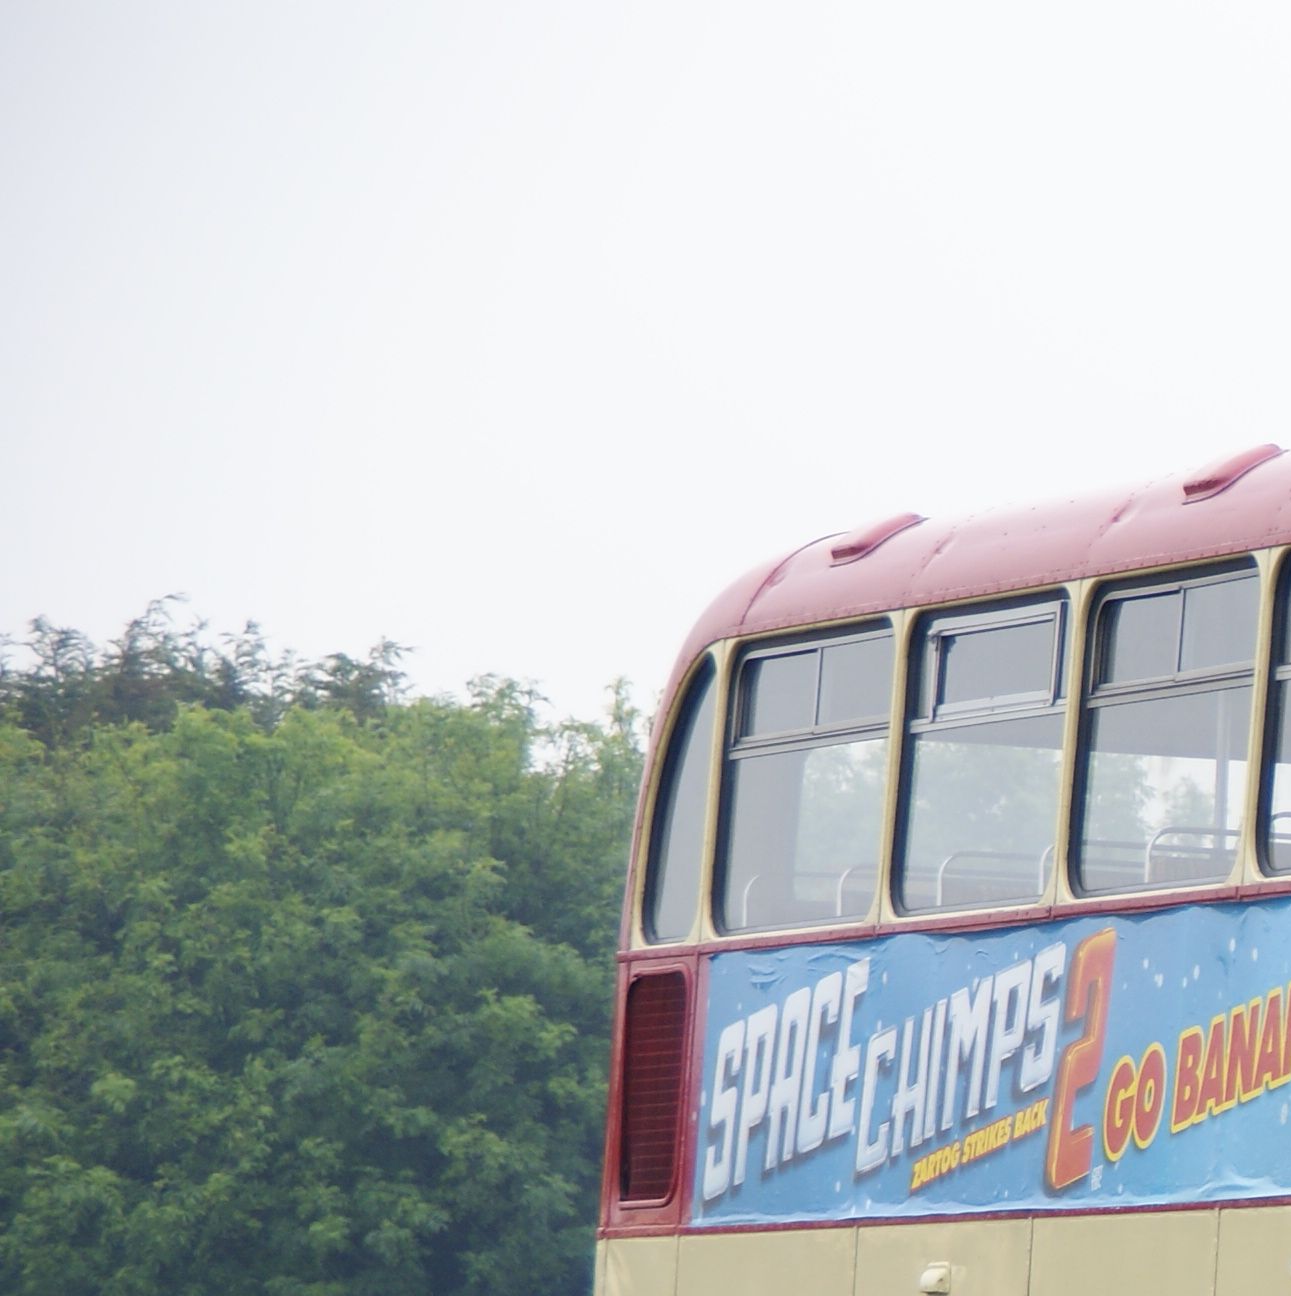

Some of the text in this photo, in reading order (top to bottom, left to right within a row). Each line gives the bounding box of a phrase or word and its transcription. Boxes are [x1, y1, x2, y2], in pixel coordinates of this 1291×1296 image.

[703, 927, 1117, 1200] SPACE CHIMPS 2
[1103, 1042, 1167, 1162] GO
[961, 1116, 1013, 1164] STRIKES
[1013, 1097, 1050, 1139] BACK
